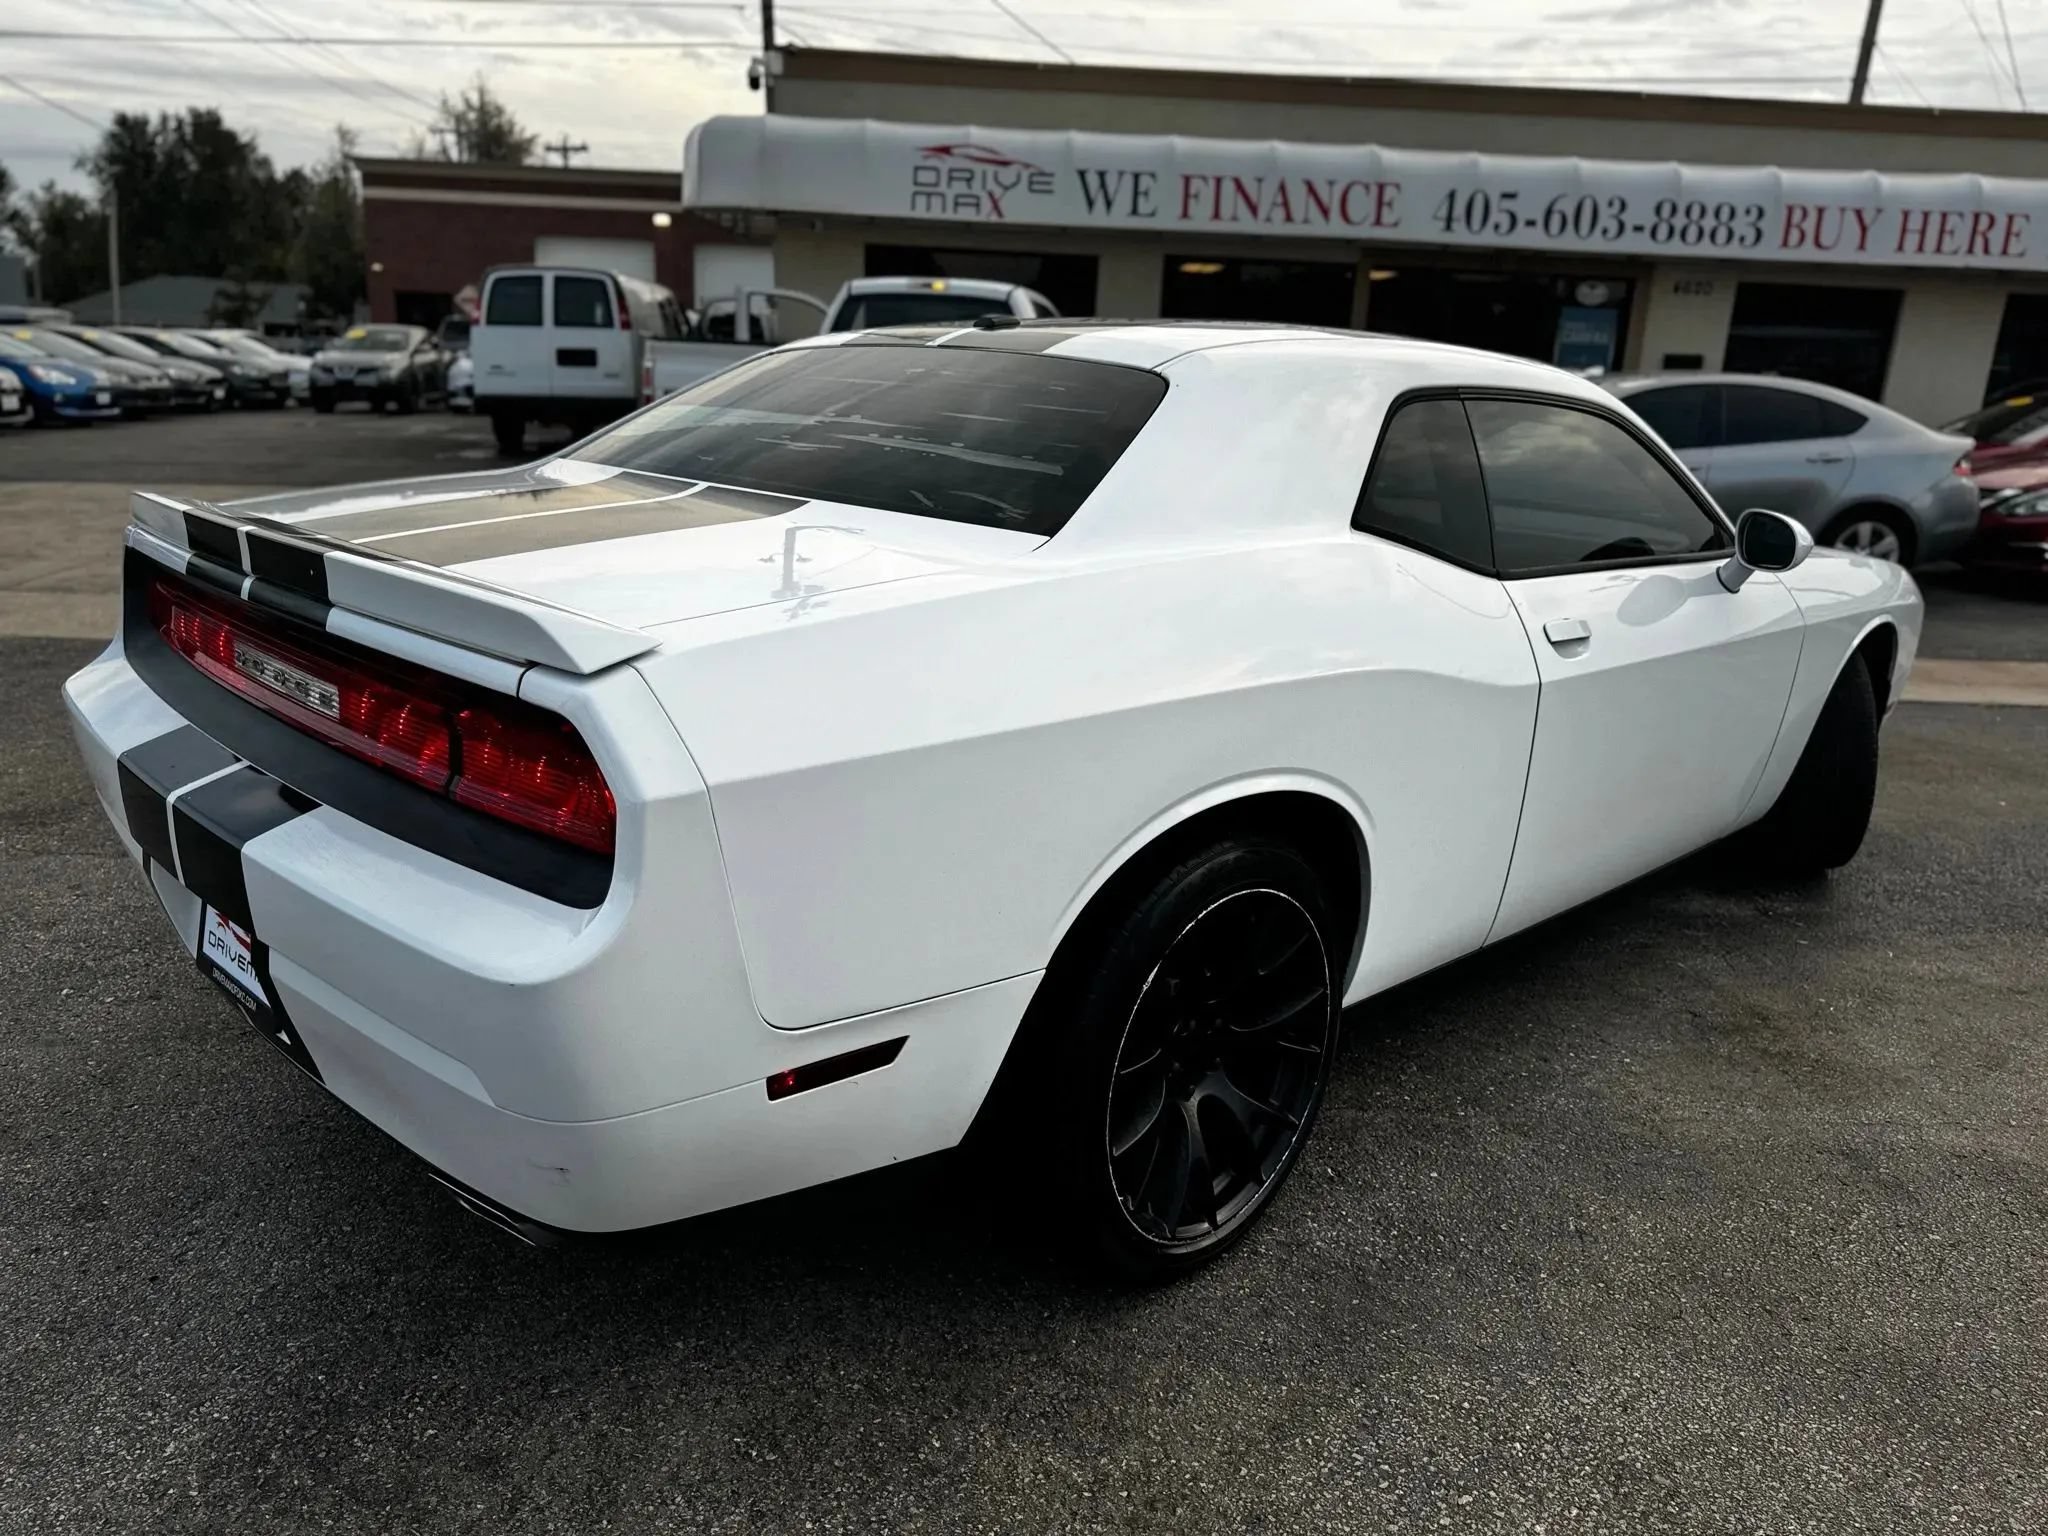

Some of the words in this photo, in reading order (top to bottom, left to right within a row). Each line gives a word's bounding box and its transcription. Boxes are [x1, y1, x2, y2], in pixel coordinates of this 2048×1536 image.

[912, 165, 1056, 194] DRIVE
[911, 190, 1004, 219] MAX
[1075, 168, 1158, 218] WE
[1178, 173, 1401, 229] FINANCE
[1431, 187, 1766, 249] 405-603-8883
[1778, 203, 1884, 253] BUY
[1894, 208, 2031, 258] HERE
[235, 649, 337, 712] DODGE
